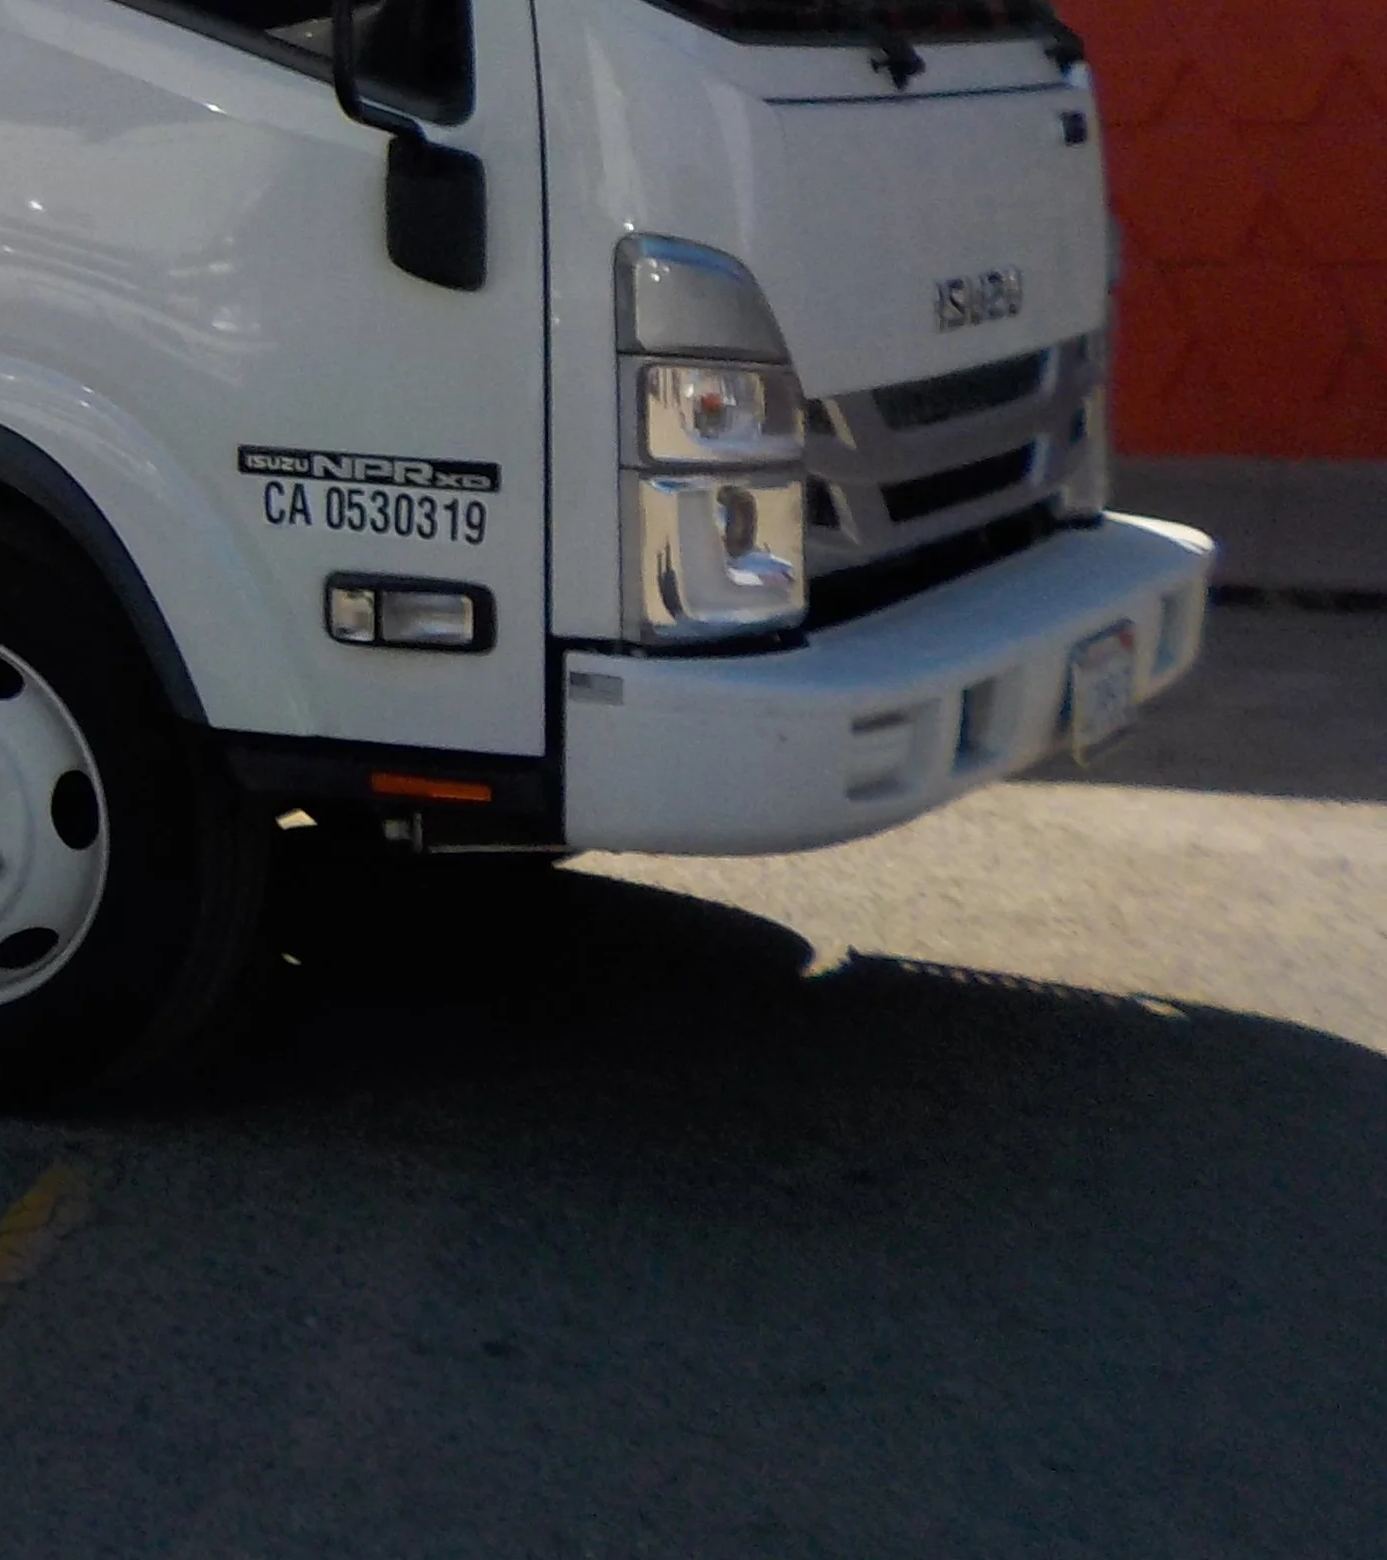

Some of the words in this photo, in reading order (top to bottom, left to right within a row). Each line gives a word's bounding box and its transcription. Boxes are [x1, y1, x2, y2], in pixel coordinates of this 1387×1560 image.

[934, 265, 1023, 332] ISUZU
[243, 453, 310, 472] ISUZU
[313, 454, 434, 486] NPR
[264, 481, 312, 526] CA
[326, 487, 488, 545] 0530319
